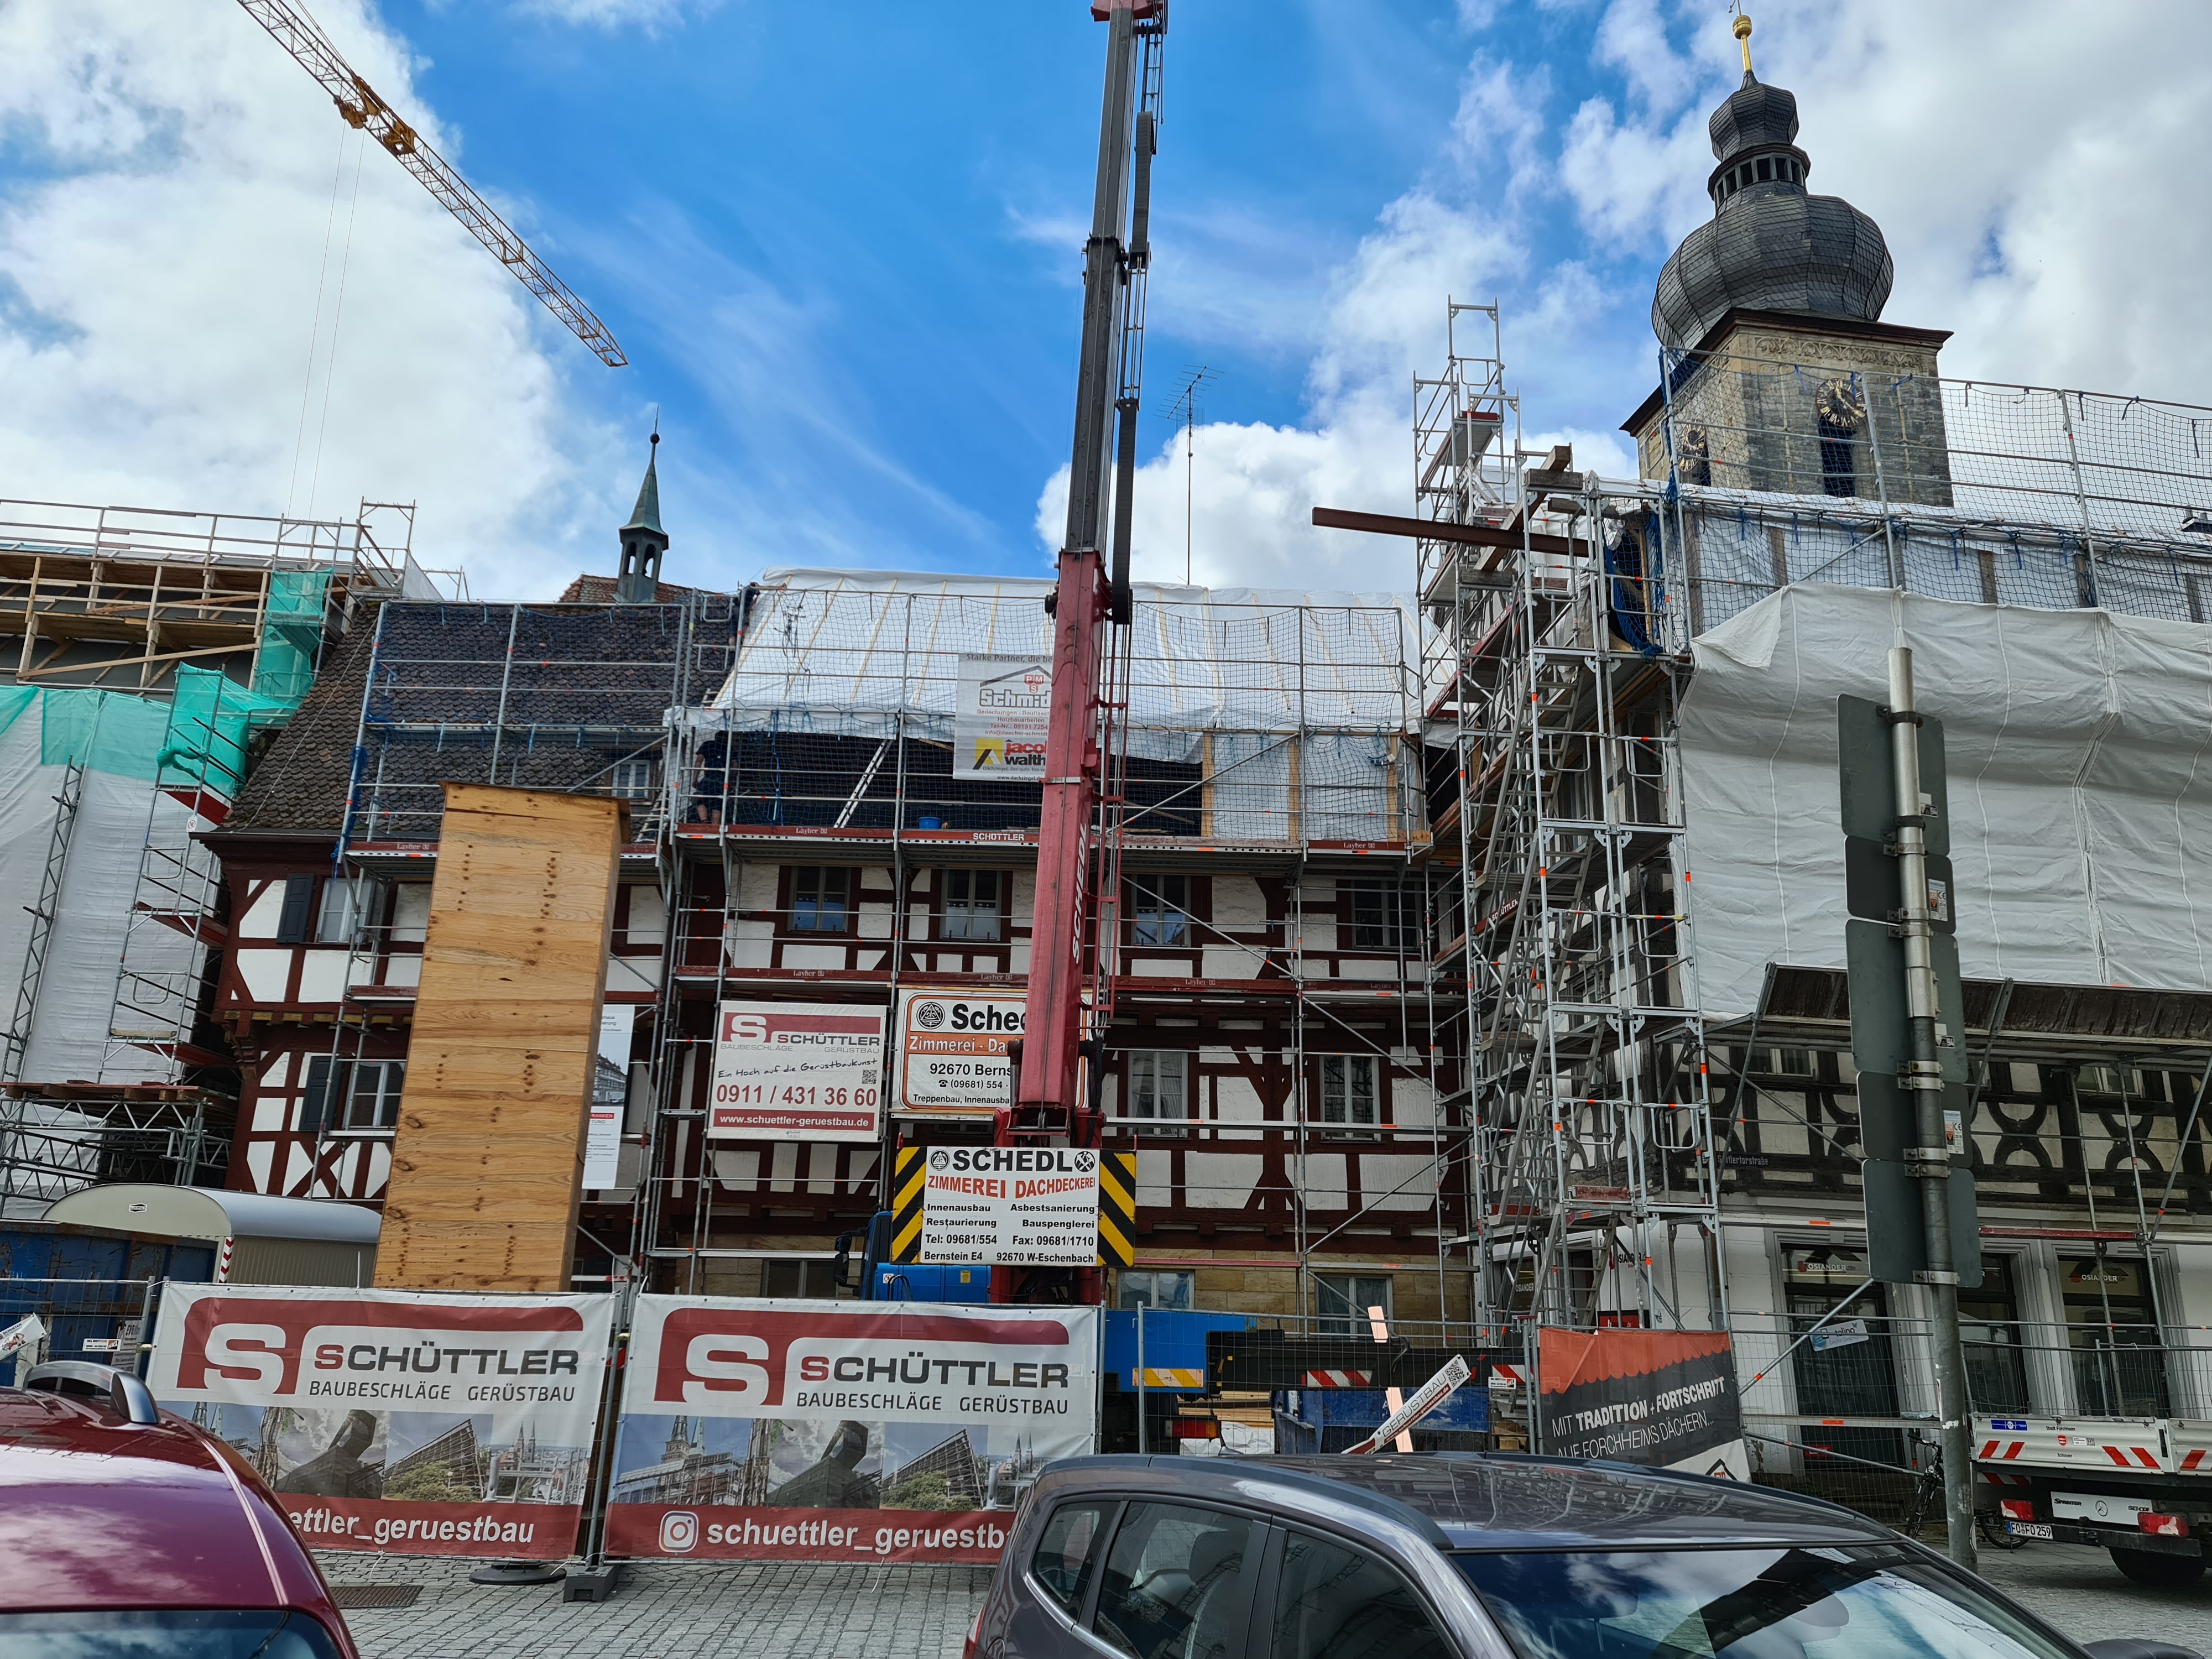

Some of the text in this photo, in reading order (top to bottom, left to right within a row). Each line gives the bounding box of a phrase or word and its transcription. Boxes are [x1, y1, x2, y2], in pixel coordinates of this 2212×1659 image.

[994, 654, 1025, 663] Partner,
[979, 688, 1051, 708] Schmid
[1004, 754, 1046, 766] walth
[1072, 822, 1087, 964] SCHEDL
[1492, 899, 1519, 921] SCÜTTLER
[777, 1033, 880, 1046] SCHÜTTLER
[909, 1035, 976, 1052] Zimmerei
[718, 1057, 878, 1078] Ein Hoch auf die Gerüstbaukunst
[930, 1063, 1010, 1076] 92670 Berns
[951, 1079, 1003, 1089] (09681) 554
[717, 1084, 877, 1107] 0911 / 431 36 60
[913, 1094, 1010, 1104] Treppenbau, Innenausba
[719, 1114, 869, 1127] www.schuettler-geruestbau.de
[952, 1150, 1073, 1172] SCHEDL
[1717, 1154, 1768, 1167] Stlertorstraße
[927, 1175, 1095, 1199] ZIMMEREI DACHDECKEREI
[927, 1203, 1095, 1214] Innenausbau Asbestsanierung
[926, 1218, 1095, 1229] Restaurierung Bauspenglerei
[925, 1234, 1094, 1246] Tel: 09681/554 Fax: 09681/1710
[924, 1251, 1094, 1263] Bernstein E4 92670 W-Eschenbach
[314, 1340, 578, 1376] SCHÜTTLER
[800, 1352, 1068, 1389] SCHÜTTLER
[309, 1379, 575, 1402] BAUBESCHLÄGE GERÜSTBAU
[796, 1391, 1068, 1415] BAUBESCHLÄGE GERÜSTBAU
[1382, 1373, 1447, 1438] GERÜSTBAU
[1552, 1415, 1573, 1438] MIT
[1575, 1400, 1648, 1431] TRADITION
[1656, 1376, 1725, 1413] FORTSCHRITT
[1583, 1425, 1660, 1459] FORCHHEIMS
[1659, 1410, 1714, 1441] DÄCHERN...
[289, 1507, 535, 1545] ettler_geruestbau
[2011, 1522, 2051, 1537] FO FO 259
